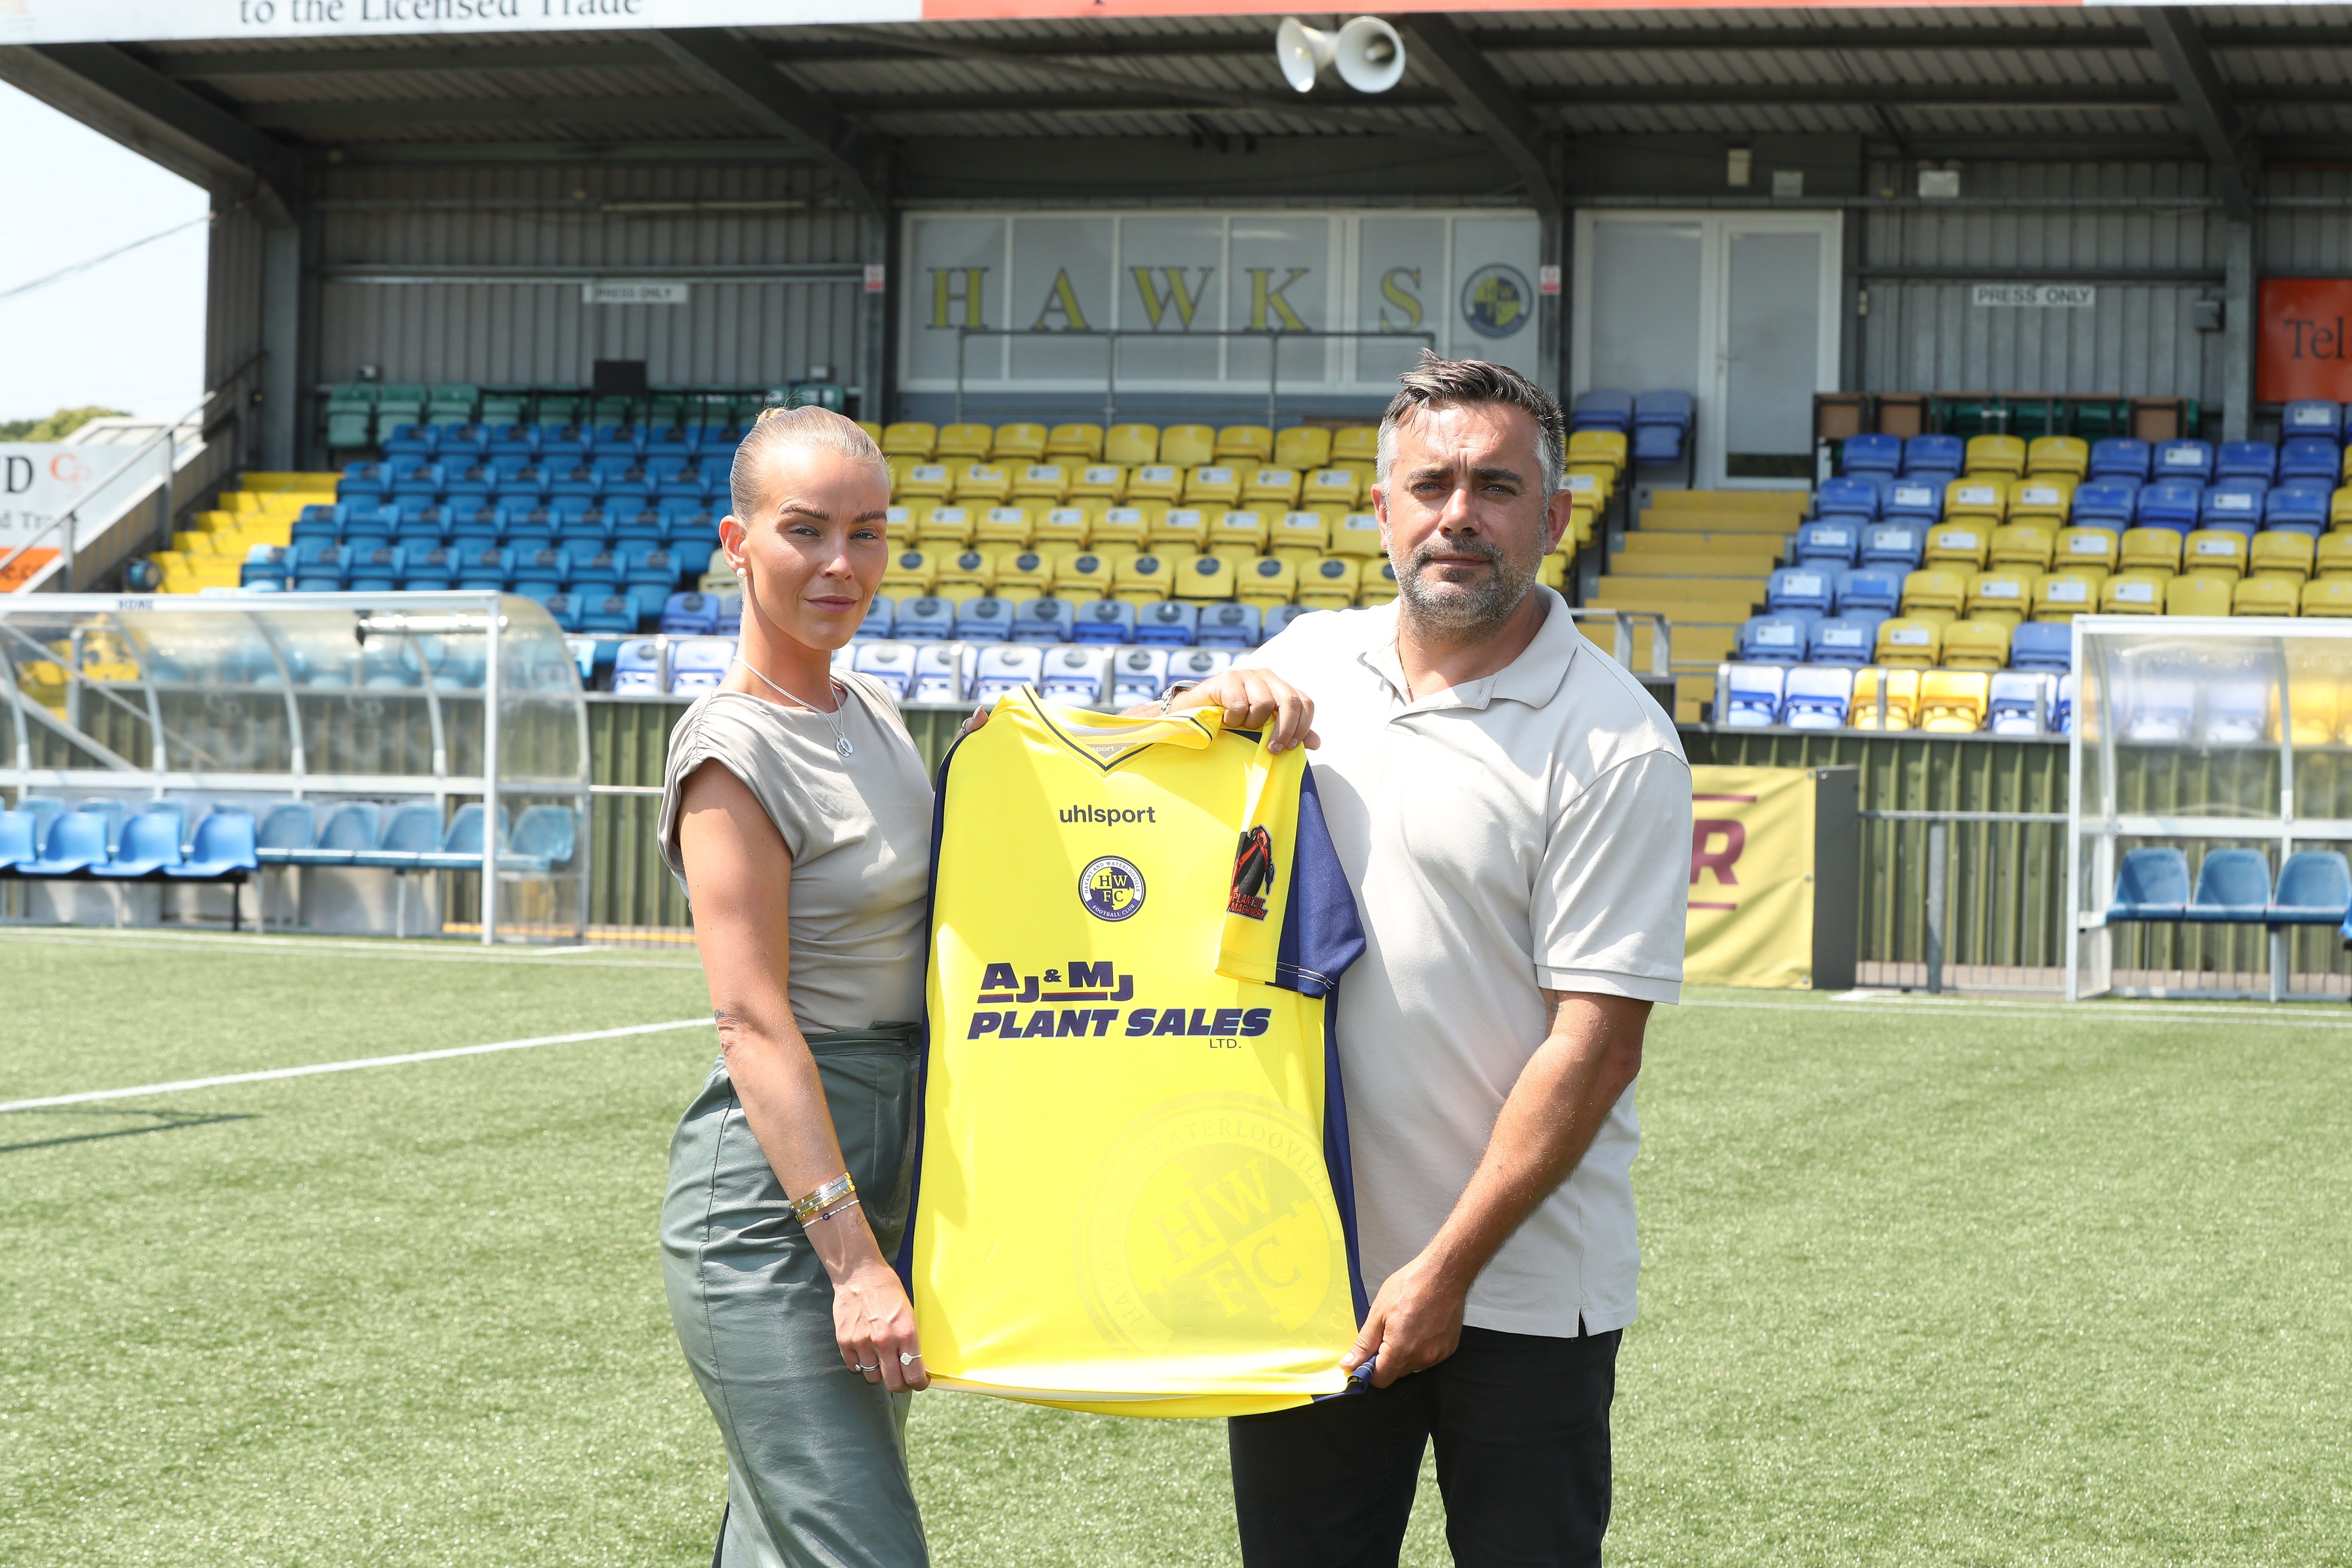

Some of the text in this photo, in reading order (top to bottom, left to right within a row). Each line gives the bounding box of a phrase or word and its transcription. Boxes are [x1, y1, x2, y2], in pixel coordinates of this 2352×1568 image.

[240, 0, 274, 23] to
[293, 0, 343, 22] the
[362, 0, 518, 21] Licensed
[925, 266, 1422, 333] HAWKS
[1978, 288, 2091, 303] PRESS ONLY
[1060, 804, 1156, 827] uhlsport
[1084, 861, 1140, 894] HAVANT AND WATERLOOVILLE
[1092, 904, 1135, 917] FOOTBALL CLUB
[981, 961, 1133, 1003] AJ & MJ
[967, 1008, 1272, 1040] PLANT SALES
[1209, 1038, 1242, 1049] LTD.
[1100, 1118, 1333, 1327] HAVANT AND WATERLOOVILLE
